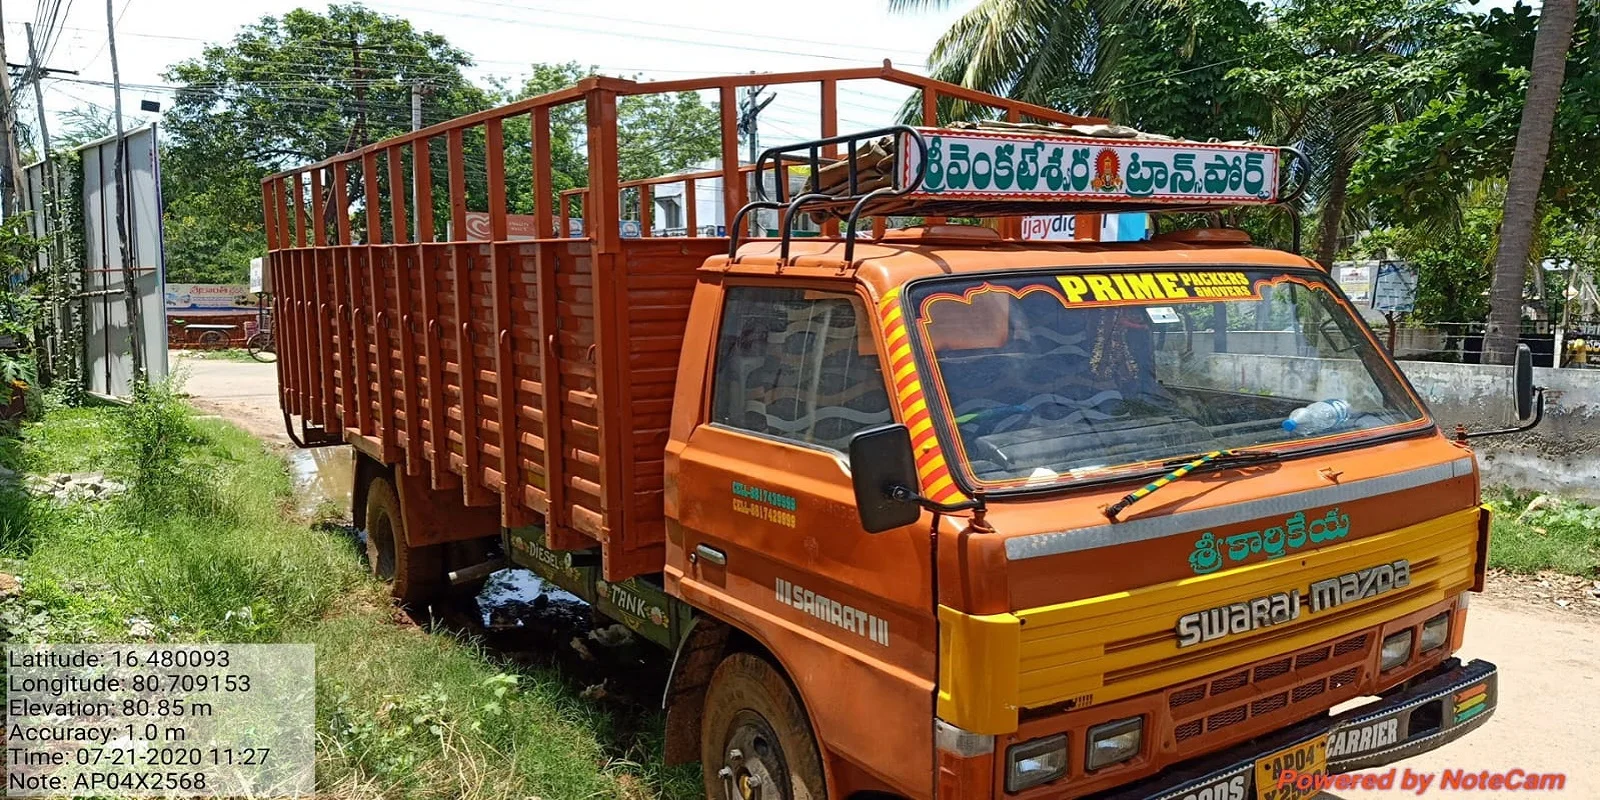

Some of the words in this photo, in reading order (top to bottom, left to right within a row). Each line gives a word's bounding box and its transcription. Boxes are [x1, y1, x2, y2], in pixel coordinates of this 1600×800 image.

[1055, 272, 1189, 303] PRIME
[1179, 271, 1250, 287] PACKERS
[611, 584, 646, 618] TANK
[793, 584, 867, 638] SAMRAT
[1326, 717, 1399, 758] CARRIER
[1272, 743, 1316, 781] AP04
